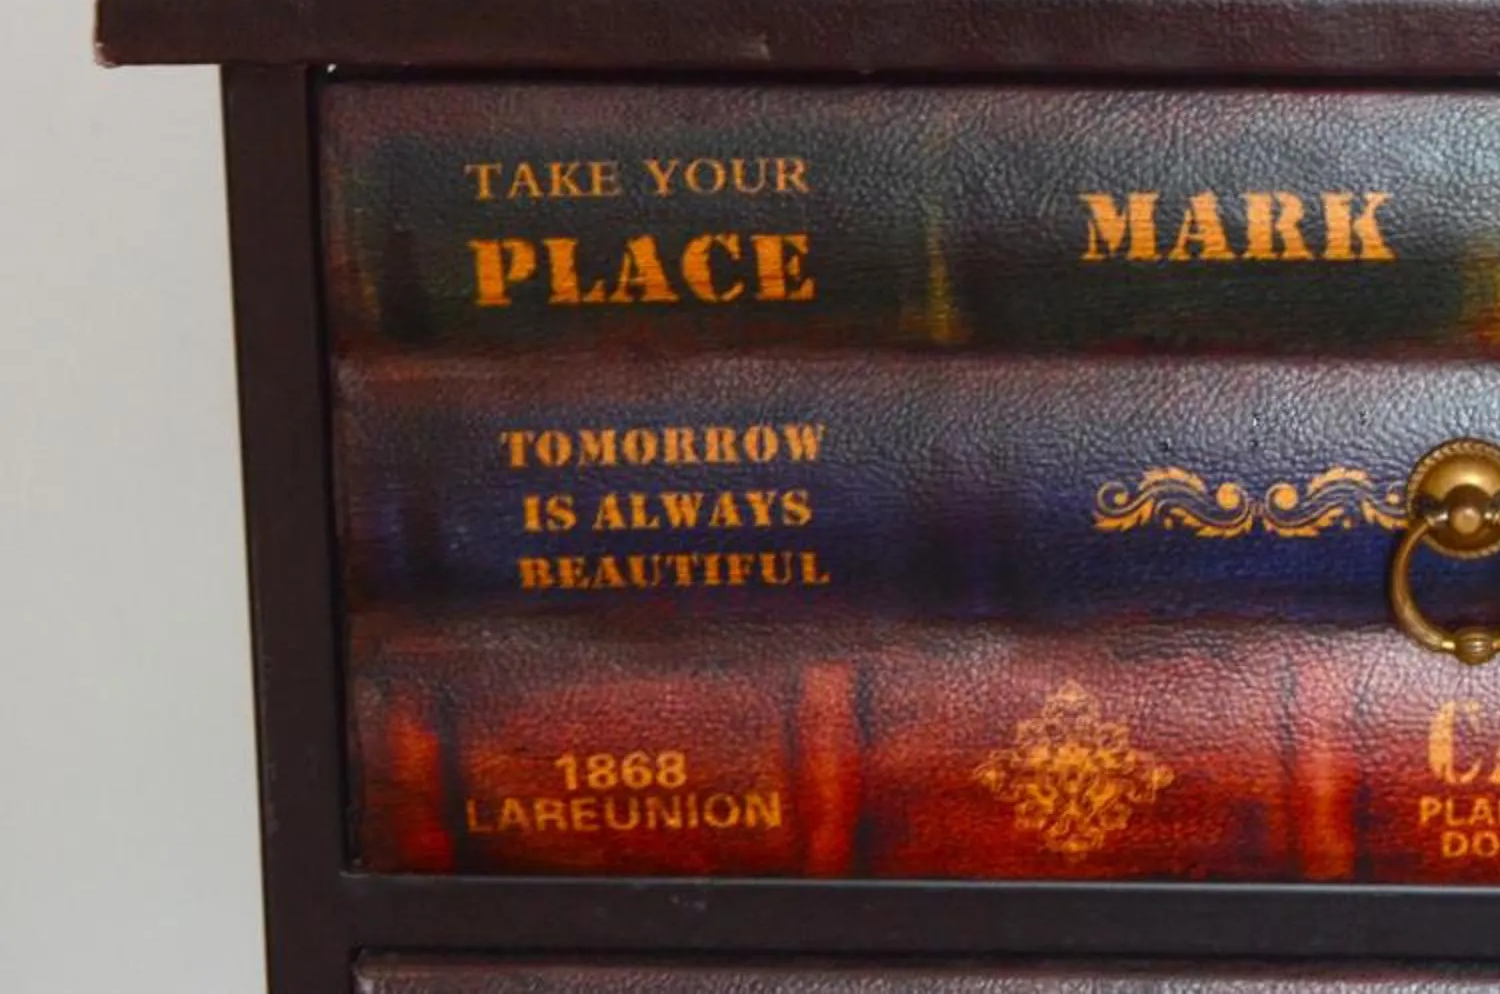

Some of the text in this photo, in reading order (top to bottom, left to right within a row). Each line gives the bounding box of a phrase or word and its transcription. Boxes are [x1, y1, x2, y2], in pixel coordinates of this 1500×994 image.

[464, 156, 813, 201] TAKE YOUR
[1078, 190, 1396, 262] MARK
[467, 233, 817, 307] PLACE
[500, 422, 827, 470] TOMORROW
[522, 489, 813, 532] IS ALWAYS
[517, 551, 831, 590] BEAUTIFUL
[553, 749, 689, 792] 1868
[465, 790, 784, 835] LAREUNION
[1440, 830, 1500, 860] DO
